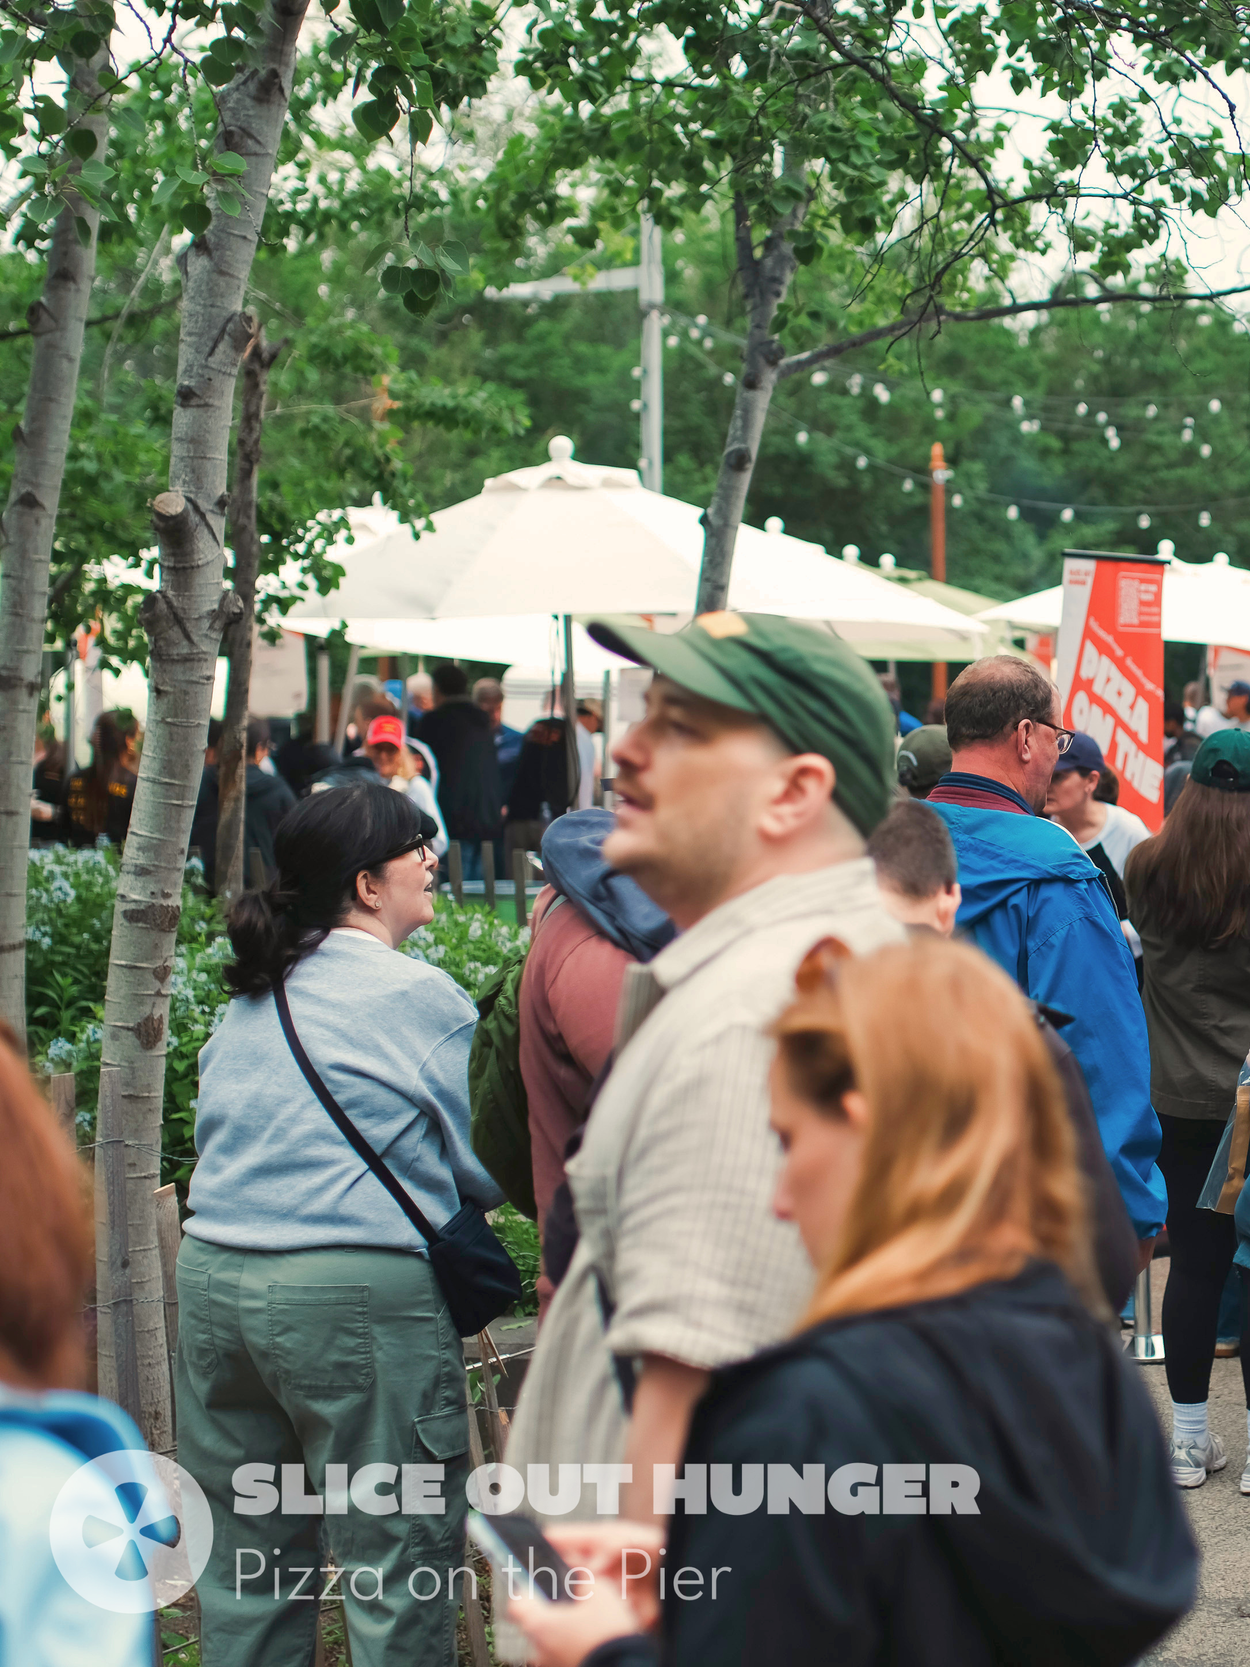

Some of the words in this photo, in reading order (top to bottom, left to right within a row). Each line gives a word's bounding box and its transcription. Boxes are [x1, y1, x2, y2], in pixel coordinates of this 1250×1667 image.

[1079, 638, 1149, 744] PIZZA
[1071, 690, 1115, 756] ON
[1115, 726, 1164, 804] THE
